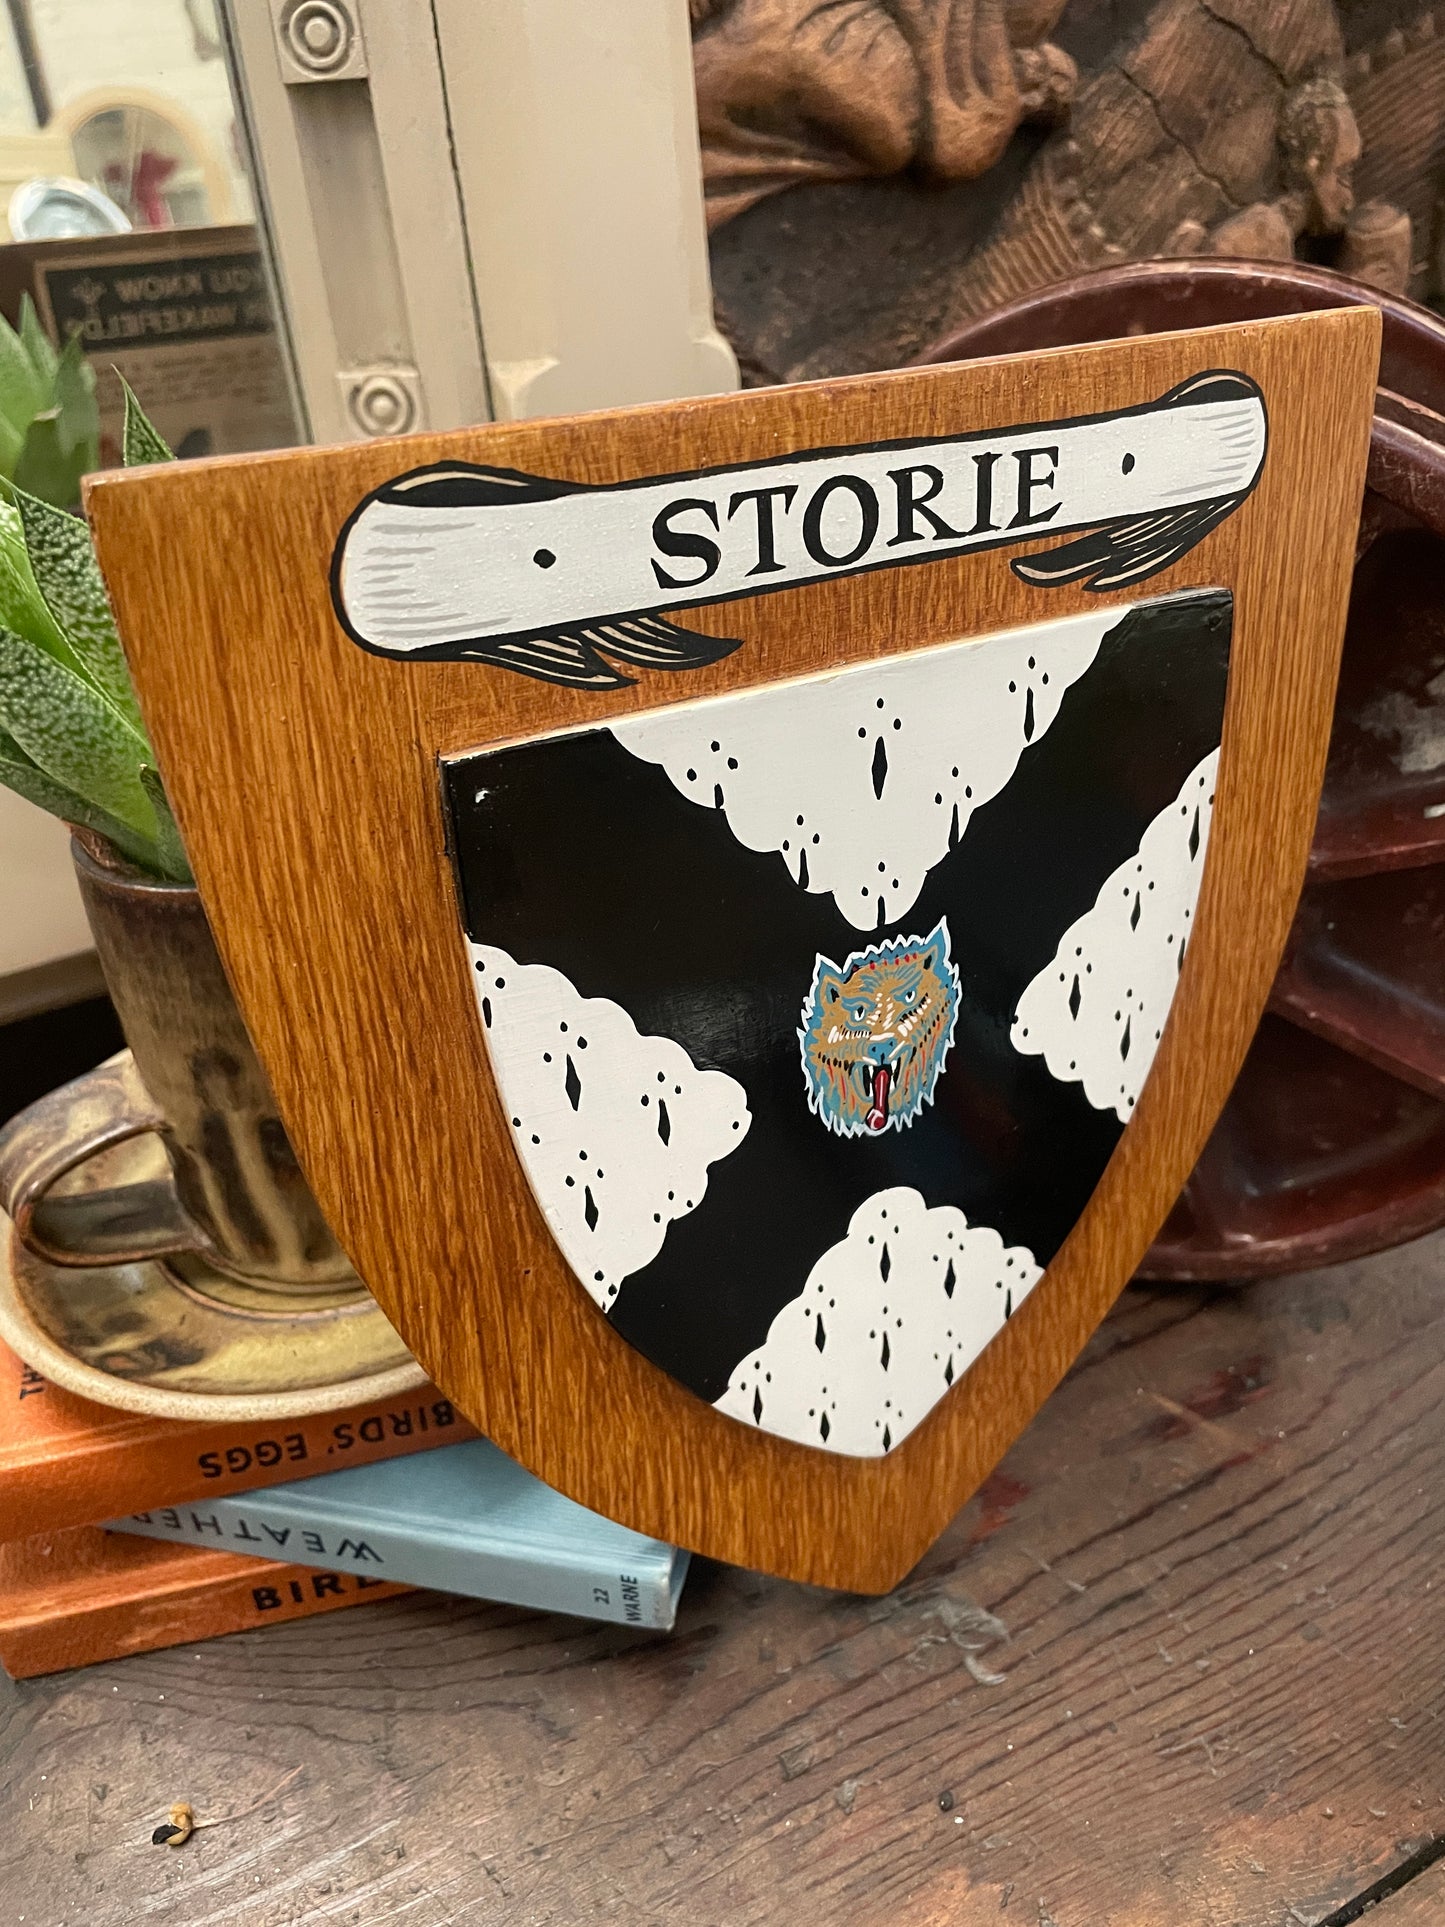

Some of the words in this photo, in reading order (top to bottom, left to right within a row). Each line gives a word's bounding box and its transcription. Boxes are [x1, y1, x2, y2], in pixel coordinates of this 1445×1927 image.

[649, 445, 1064, 590] STORIE
[19, 1362, 45, 1400] TH
[197, 1432, 309, 1480] EGGS
[592, 1587, 610, 1605] 22
[620, 1574, 643, 1622] WARNE
